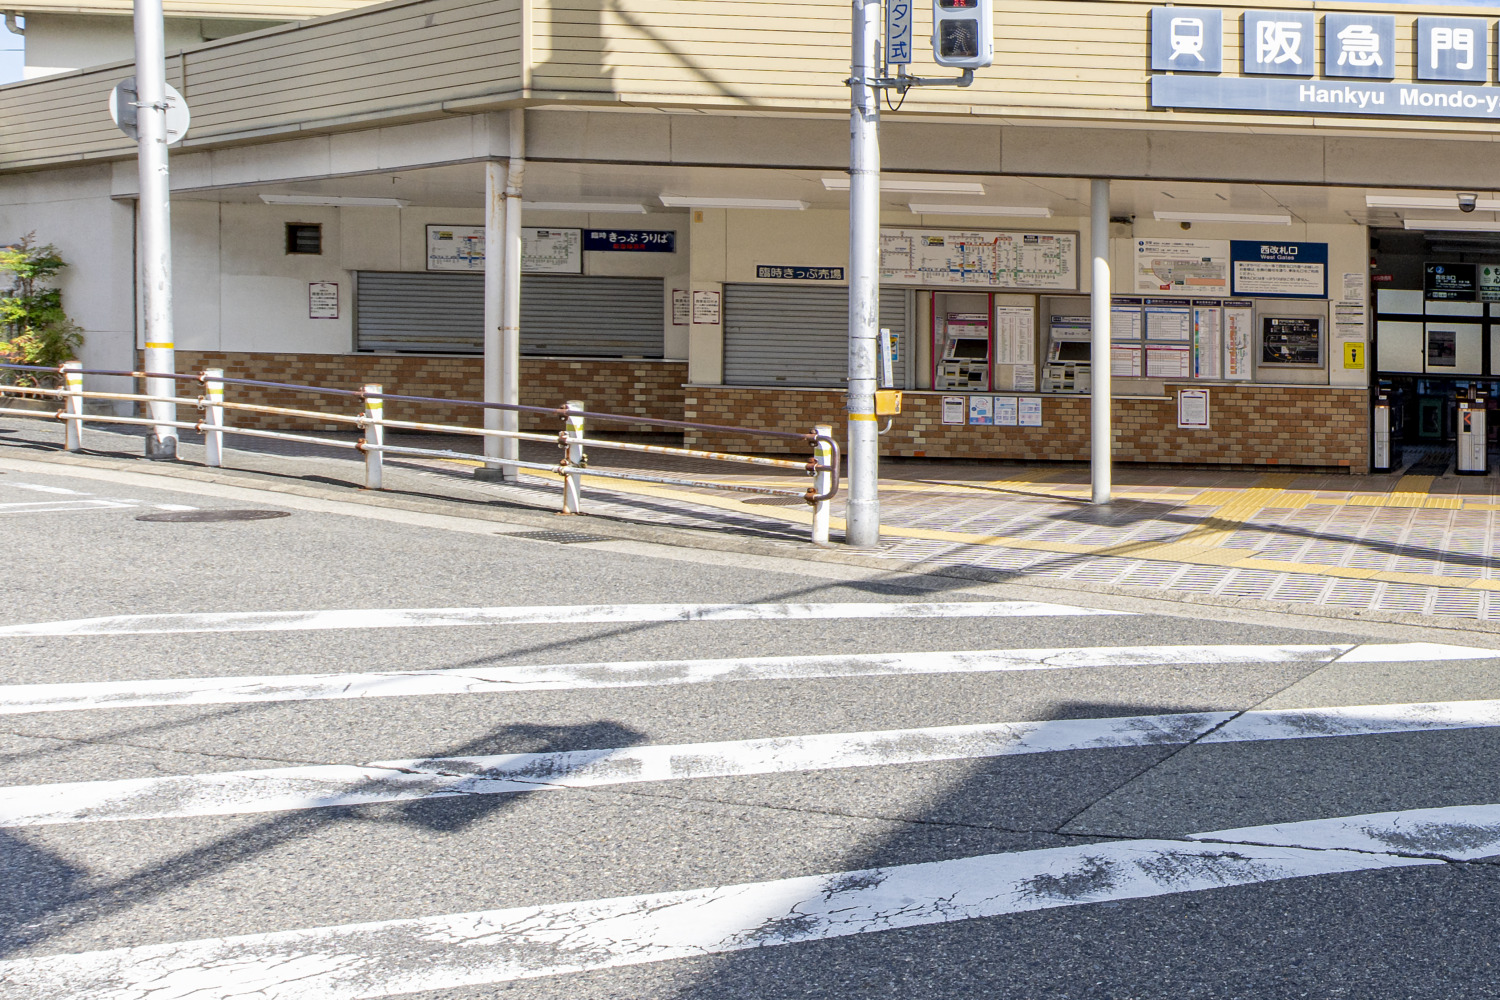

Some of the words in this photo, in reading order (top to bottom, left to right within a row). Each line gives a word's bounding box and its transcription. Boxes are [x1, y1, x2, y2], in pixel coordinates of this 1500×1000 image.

[1299, 84, 1386, 109] Hankyu
[1260, 246, 1298, 255] 西改札口
[758, 267, 842, 280] 臨時きっぷ売場
